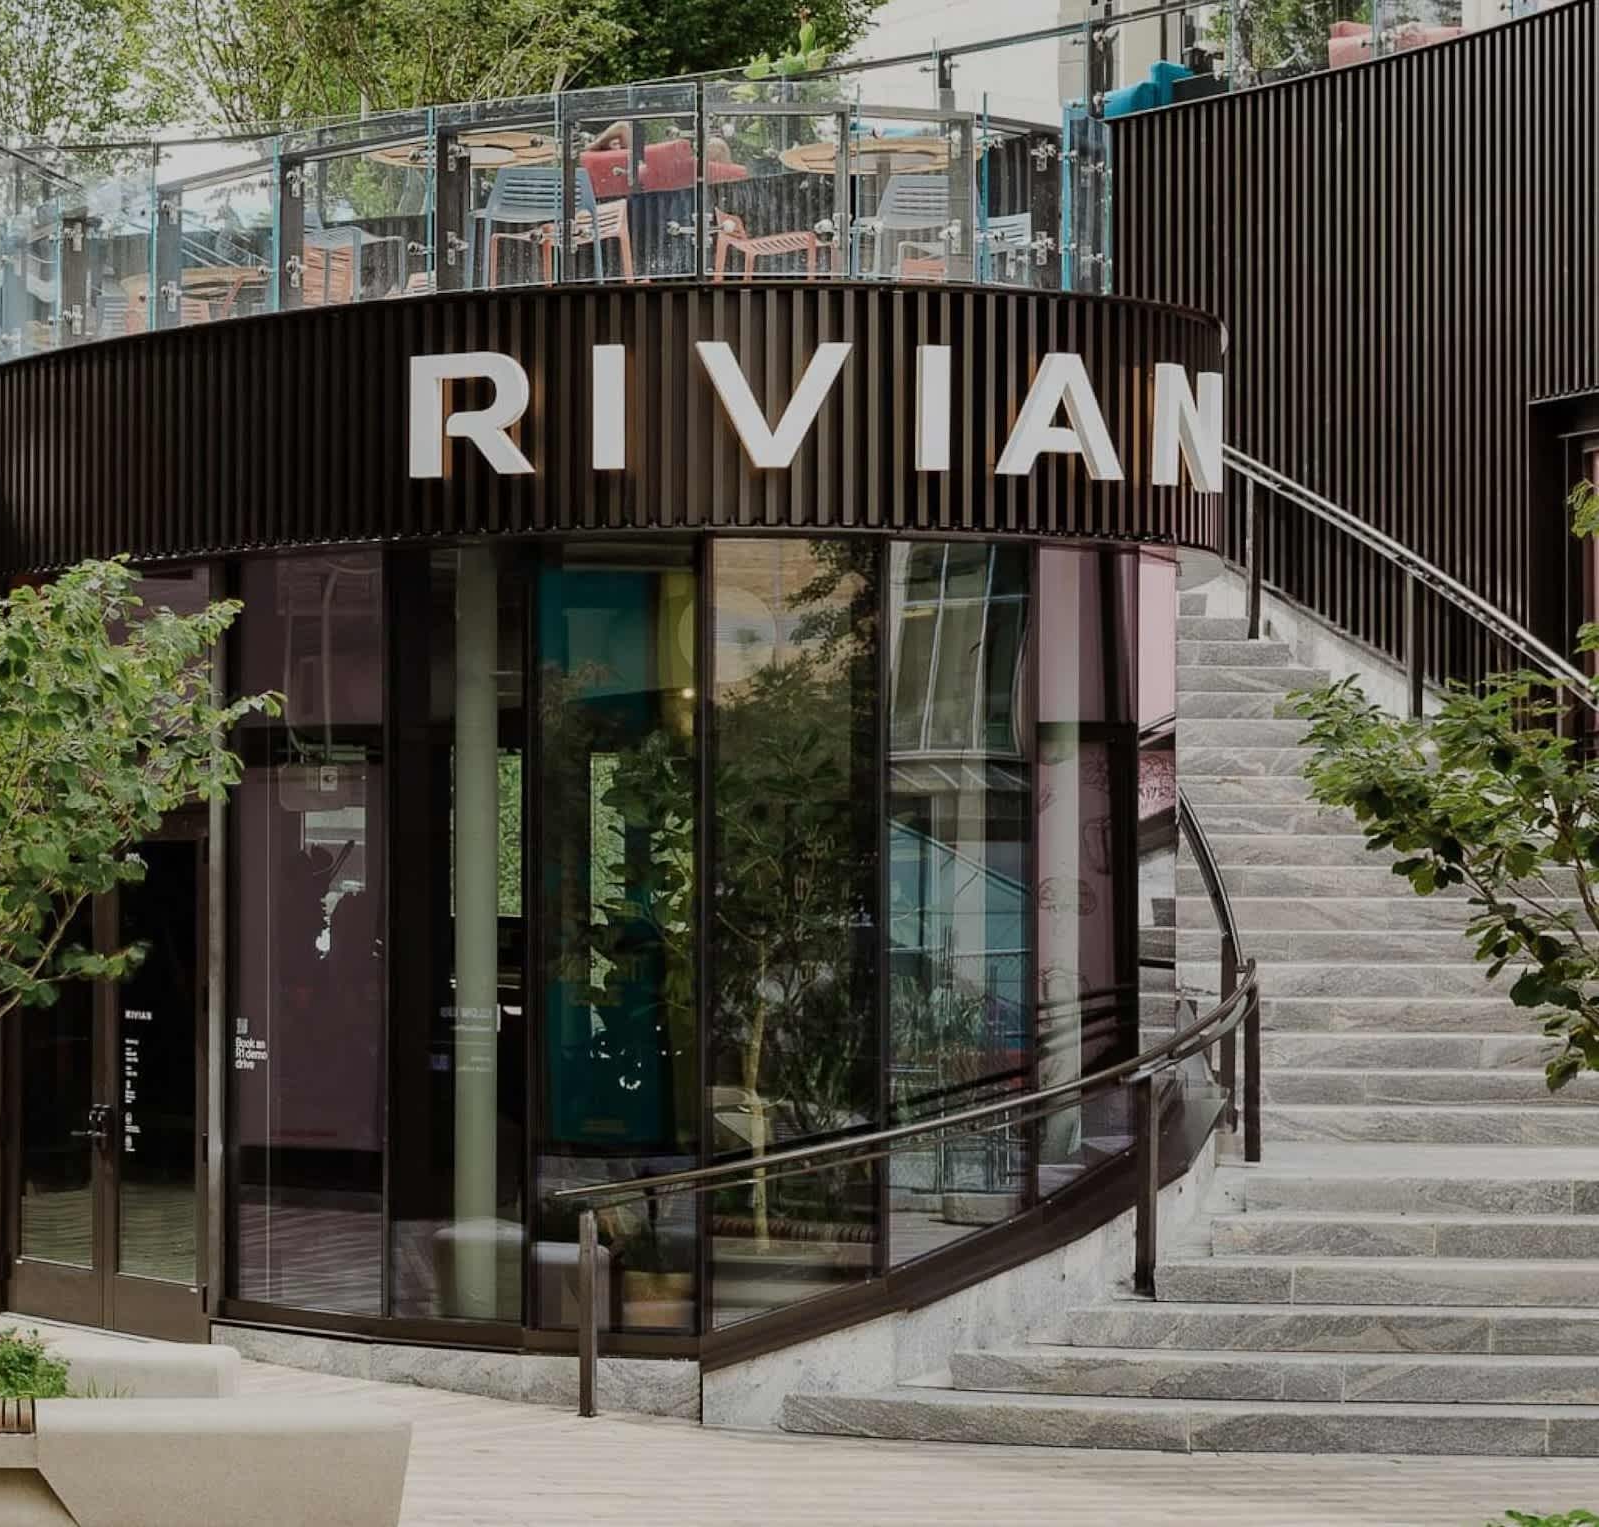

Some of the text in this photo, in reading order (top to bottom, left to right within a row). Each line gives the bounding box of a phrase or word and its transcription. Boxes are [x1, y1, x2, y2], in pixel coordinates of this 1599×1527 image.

[409, 341, 1223, 493] RIVIAN
[235, 1036, 255, 1049] Book
[245, 1049, 268, 1060] demo
